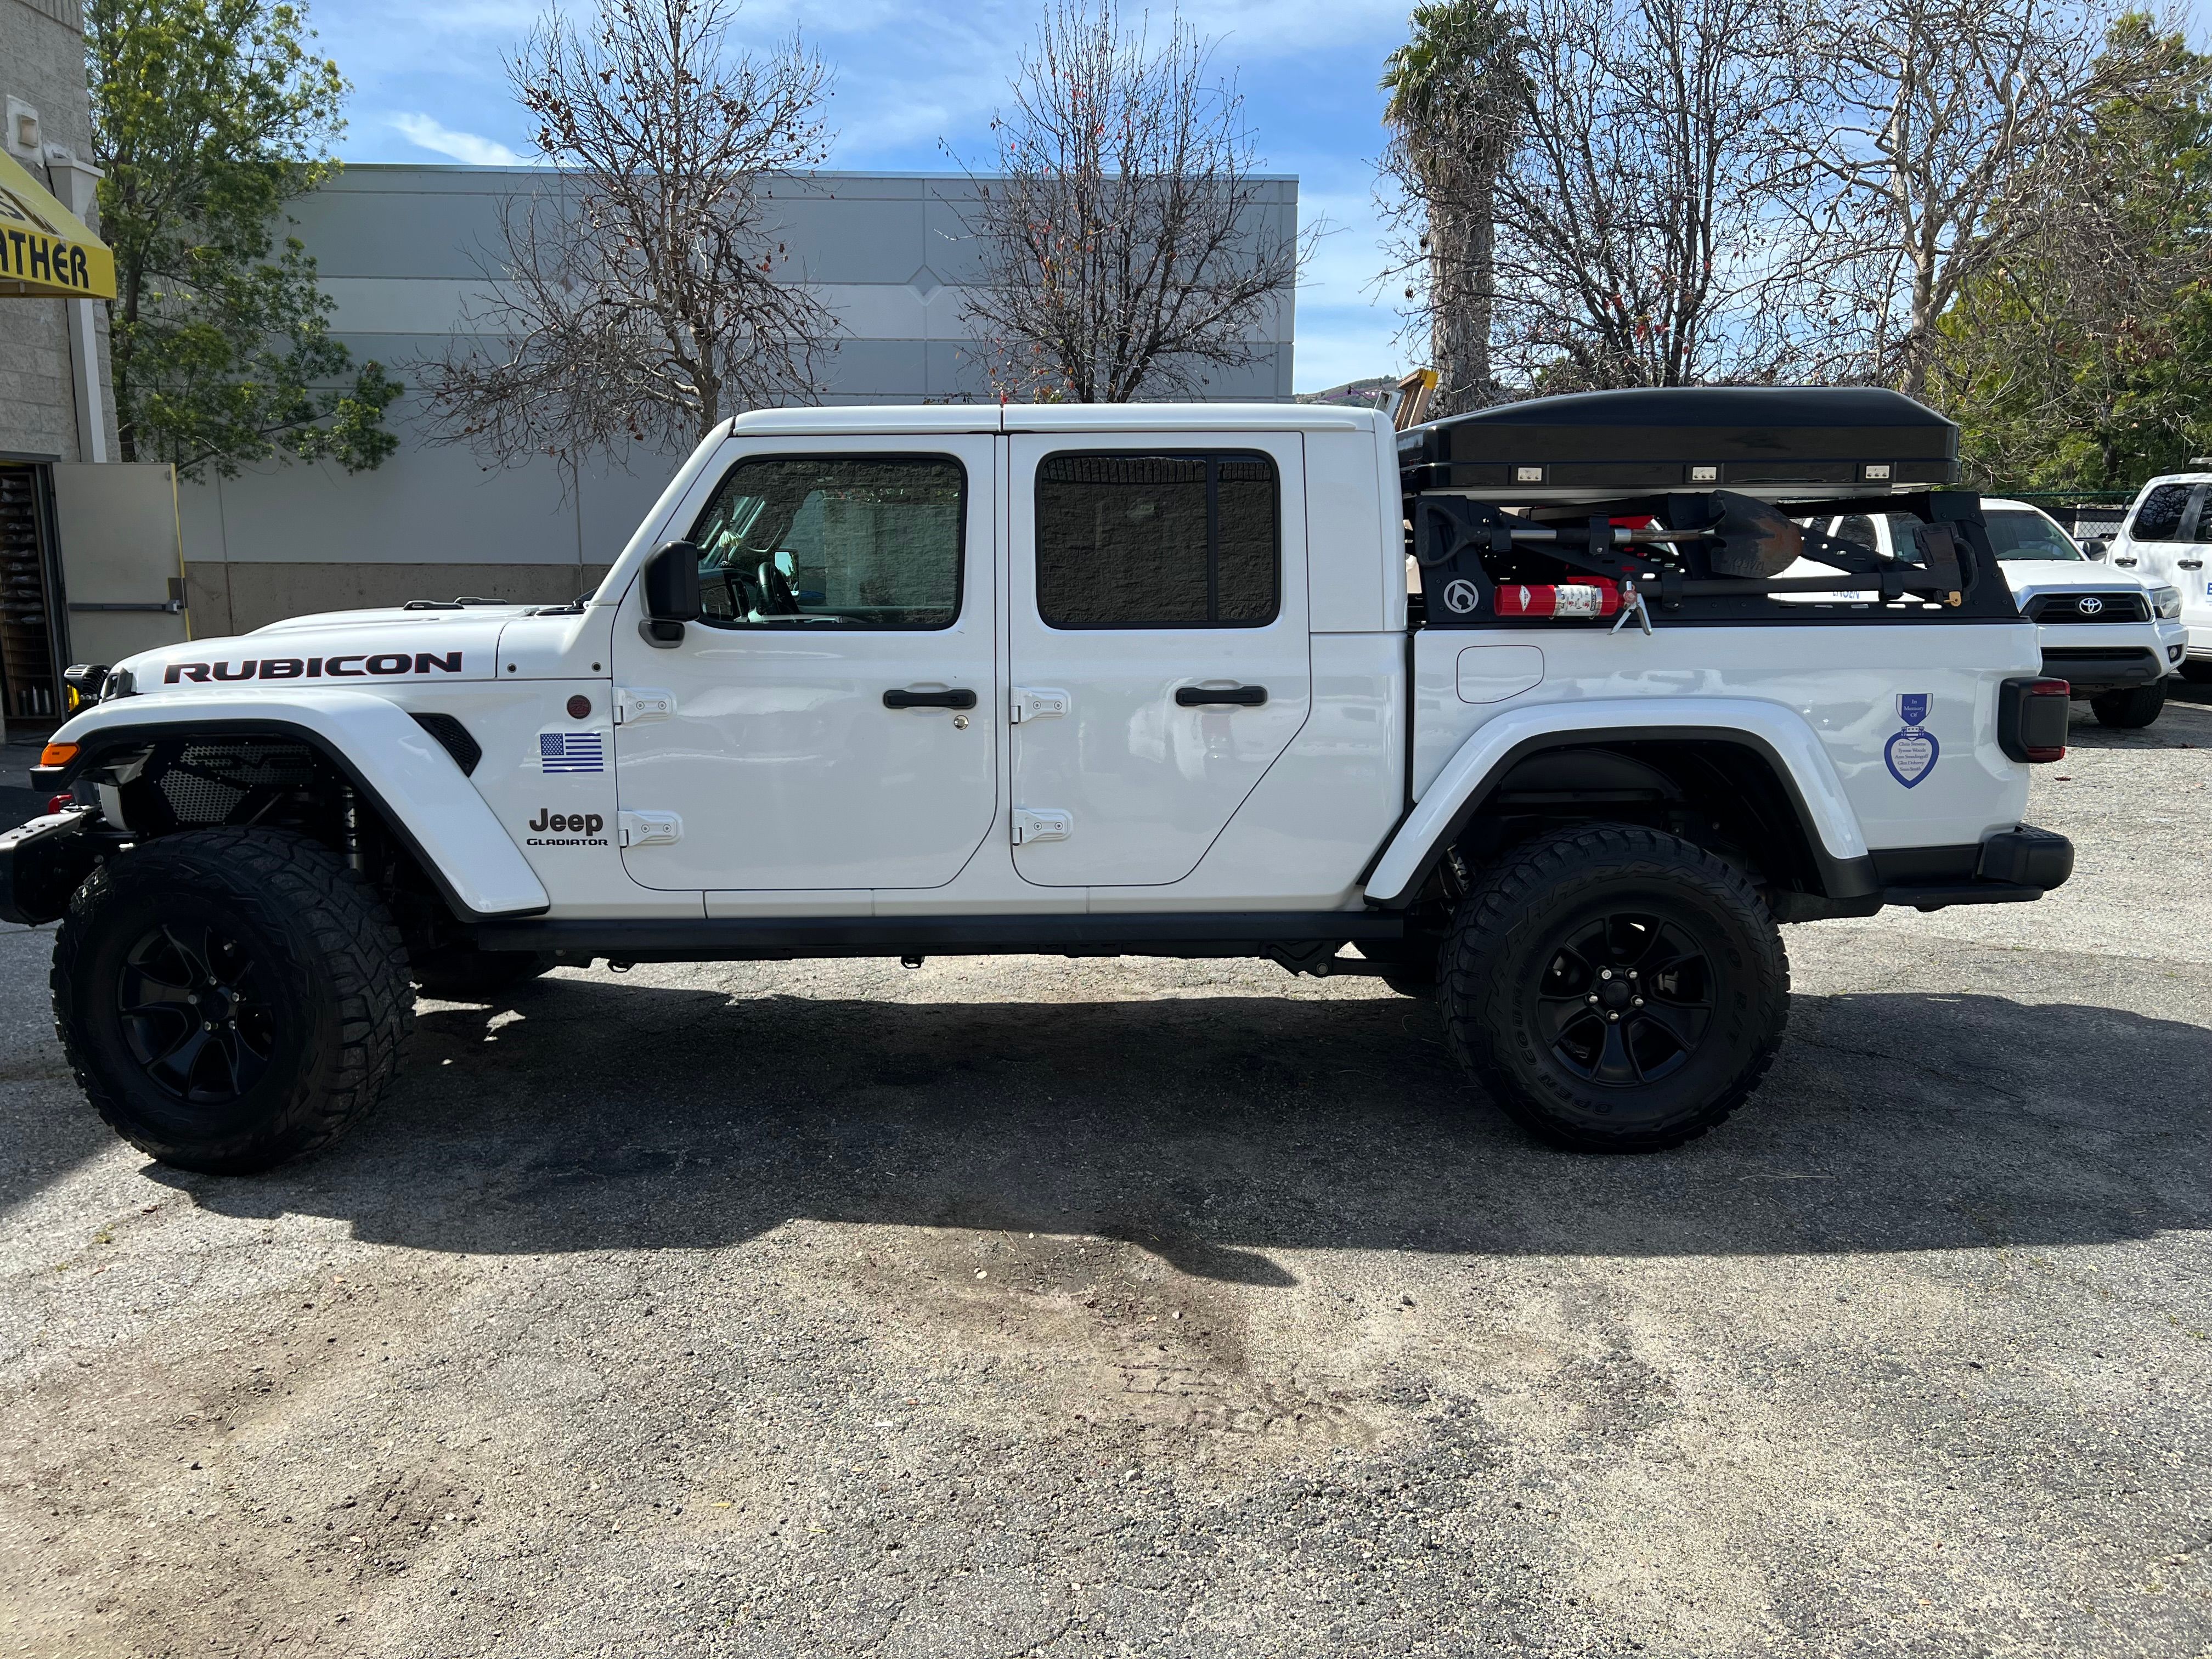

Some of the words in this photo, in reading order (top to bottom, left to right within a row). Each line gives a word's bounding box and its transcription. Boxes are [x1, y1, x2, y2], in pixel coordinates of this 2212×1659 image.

[163, 652, 462, 684] RUBICON
[529, 808, 603, 836] Jeep
[1537, 1071, 1613, 1116] OPEN
